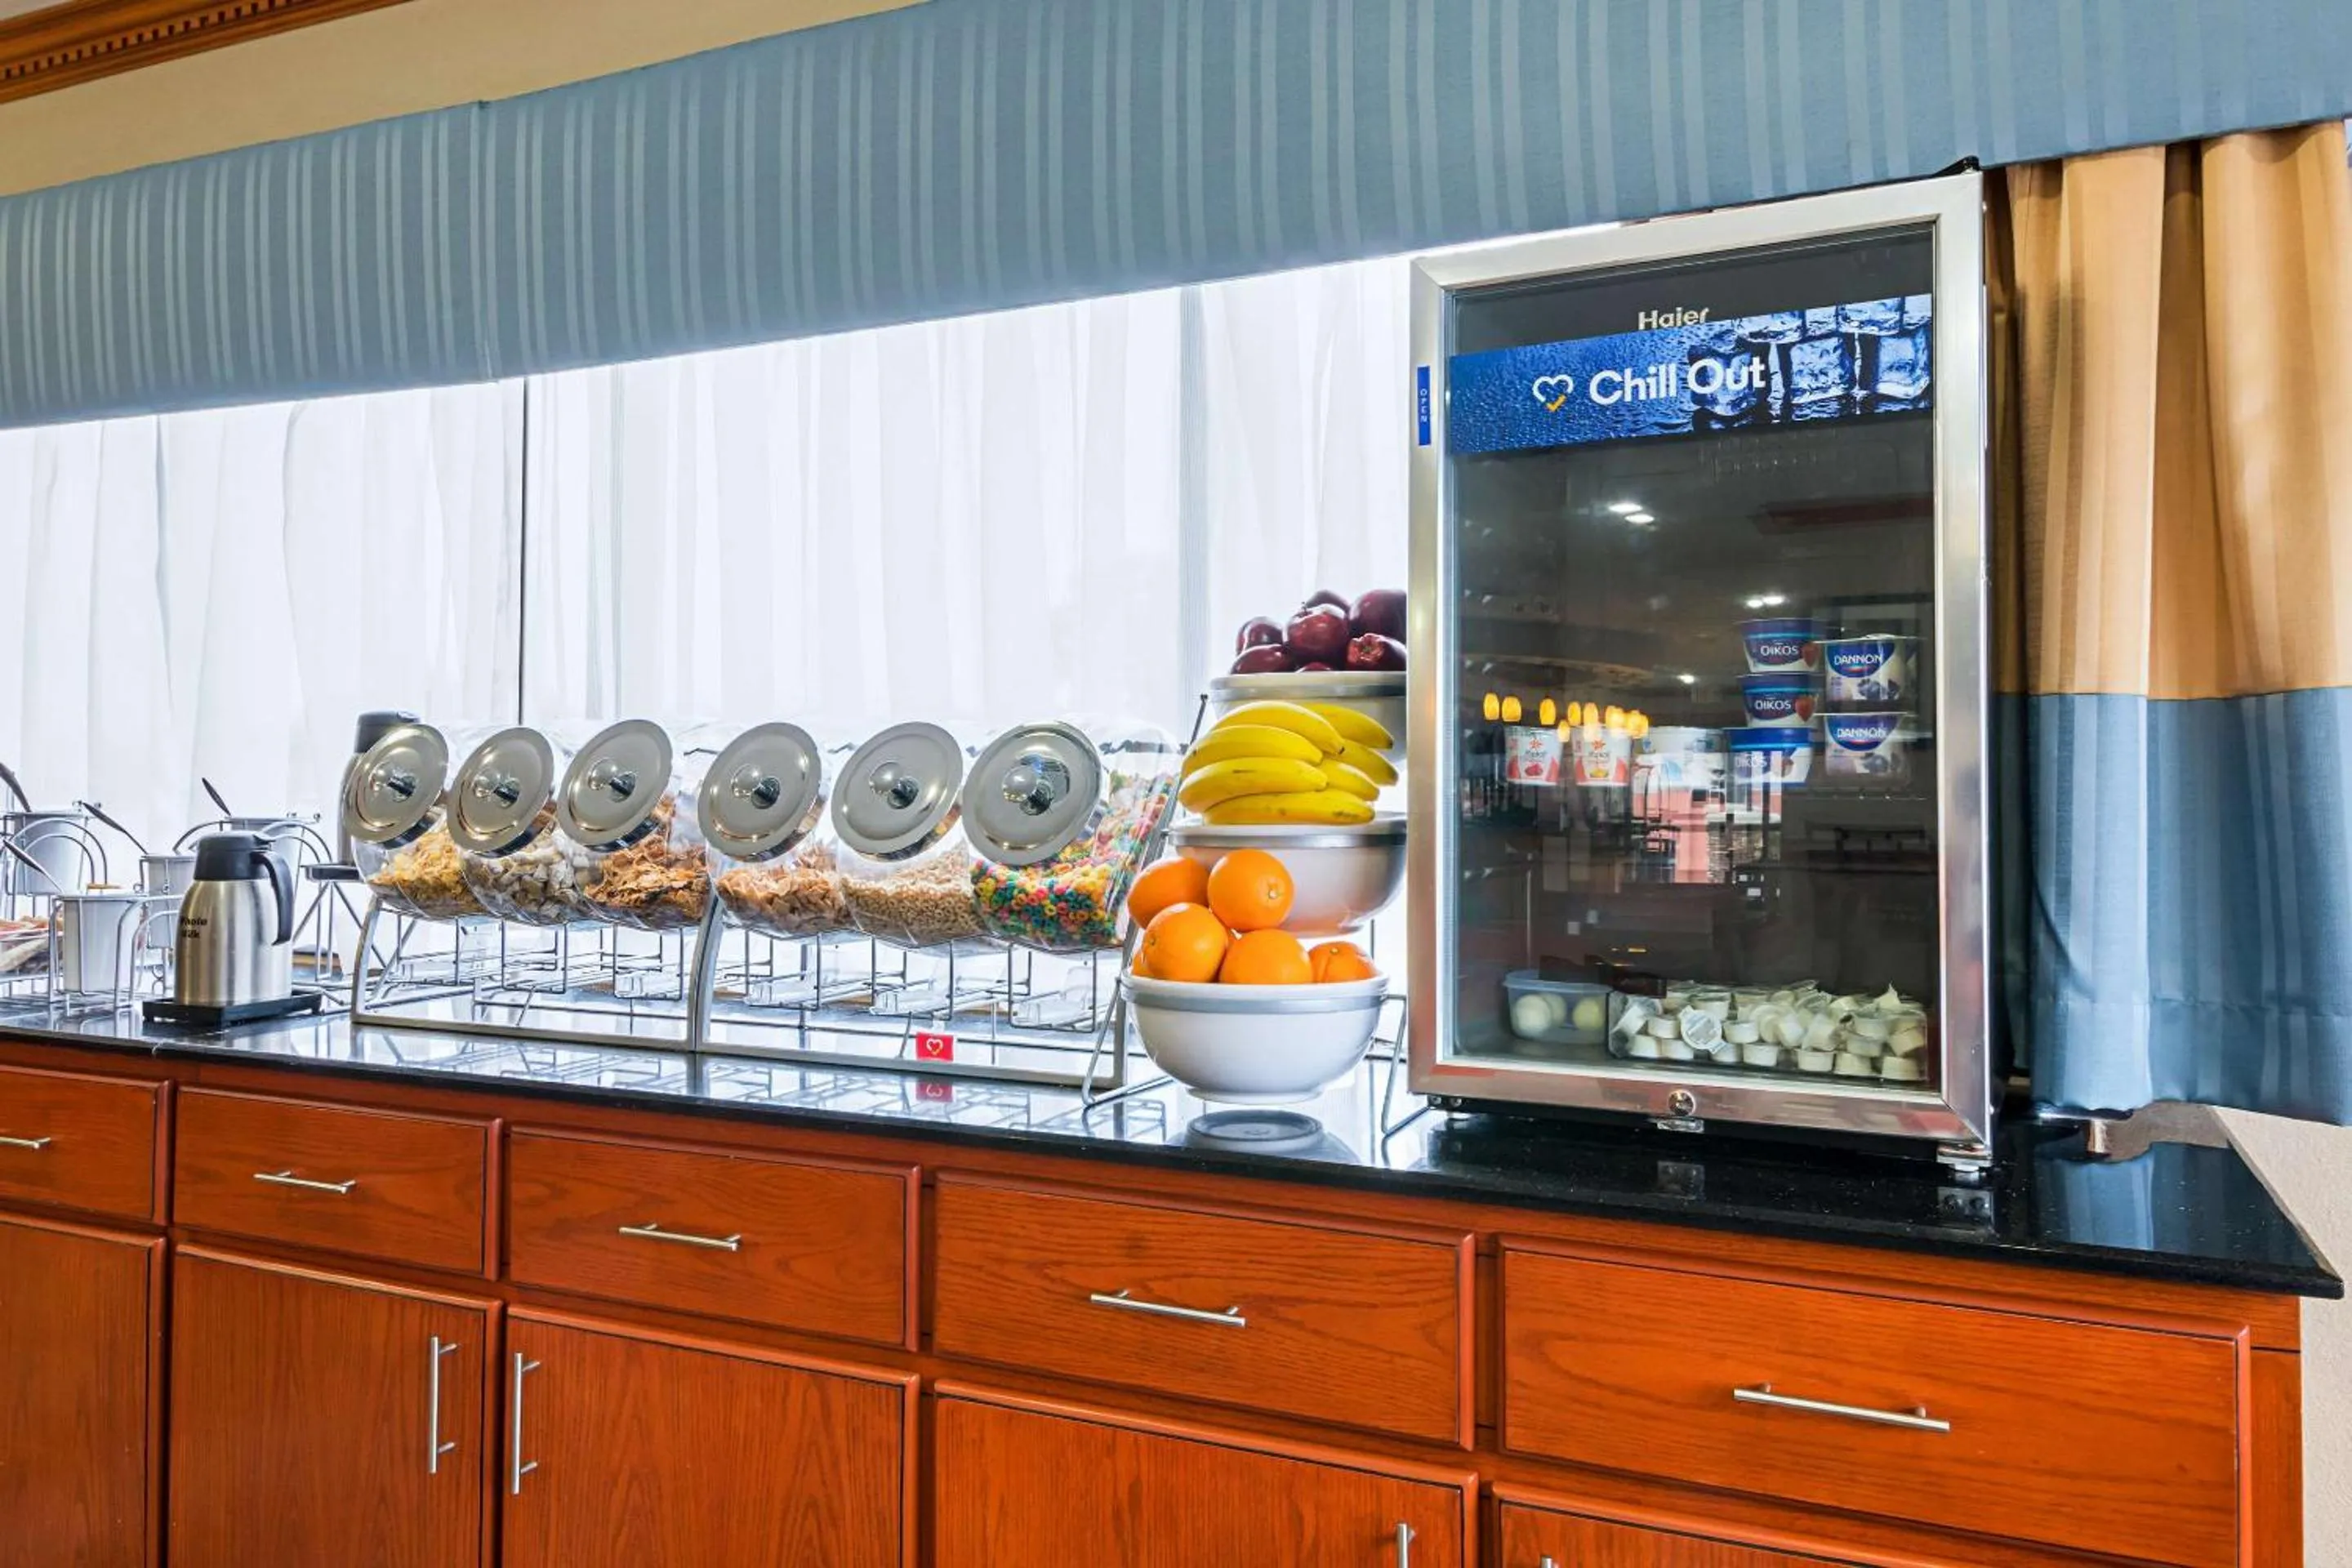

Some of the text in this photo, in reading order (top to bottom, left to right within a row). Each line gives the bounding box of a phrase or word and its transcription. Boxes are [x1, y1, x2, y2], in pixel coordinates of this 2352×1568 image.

[1638, 307, 1710, 330] Haier
[1589, 356, 1766, 405] Chill Out
[1760, 645, 1799, 656] OIKOS
[1834, 654, 1882, 665] DANNON
[1754, 700, 1791, 710] OIKOS
[1838, 728, 1886, 738] DANNON
